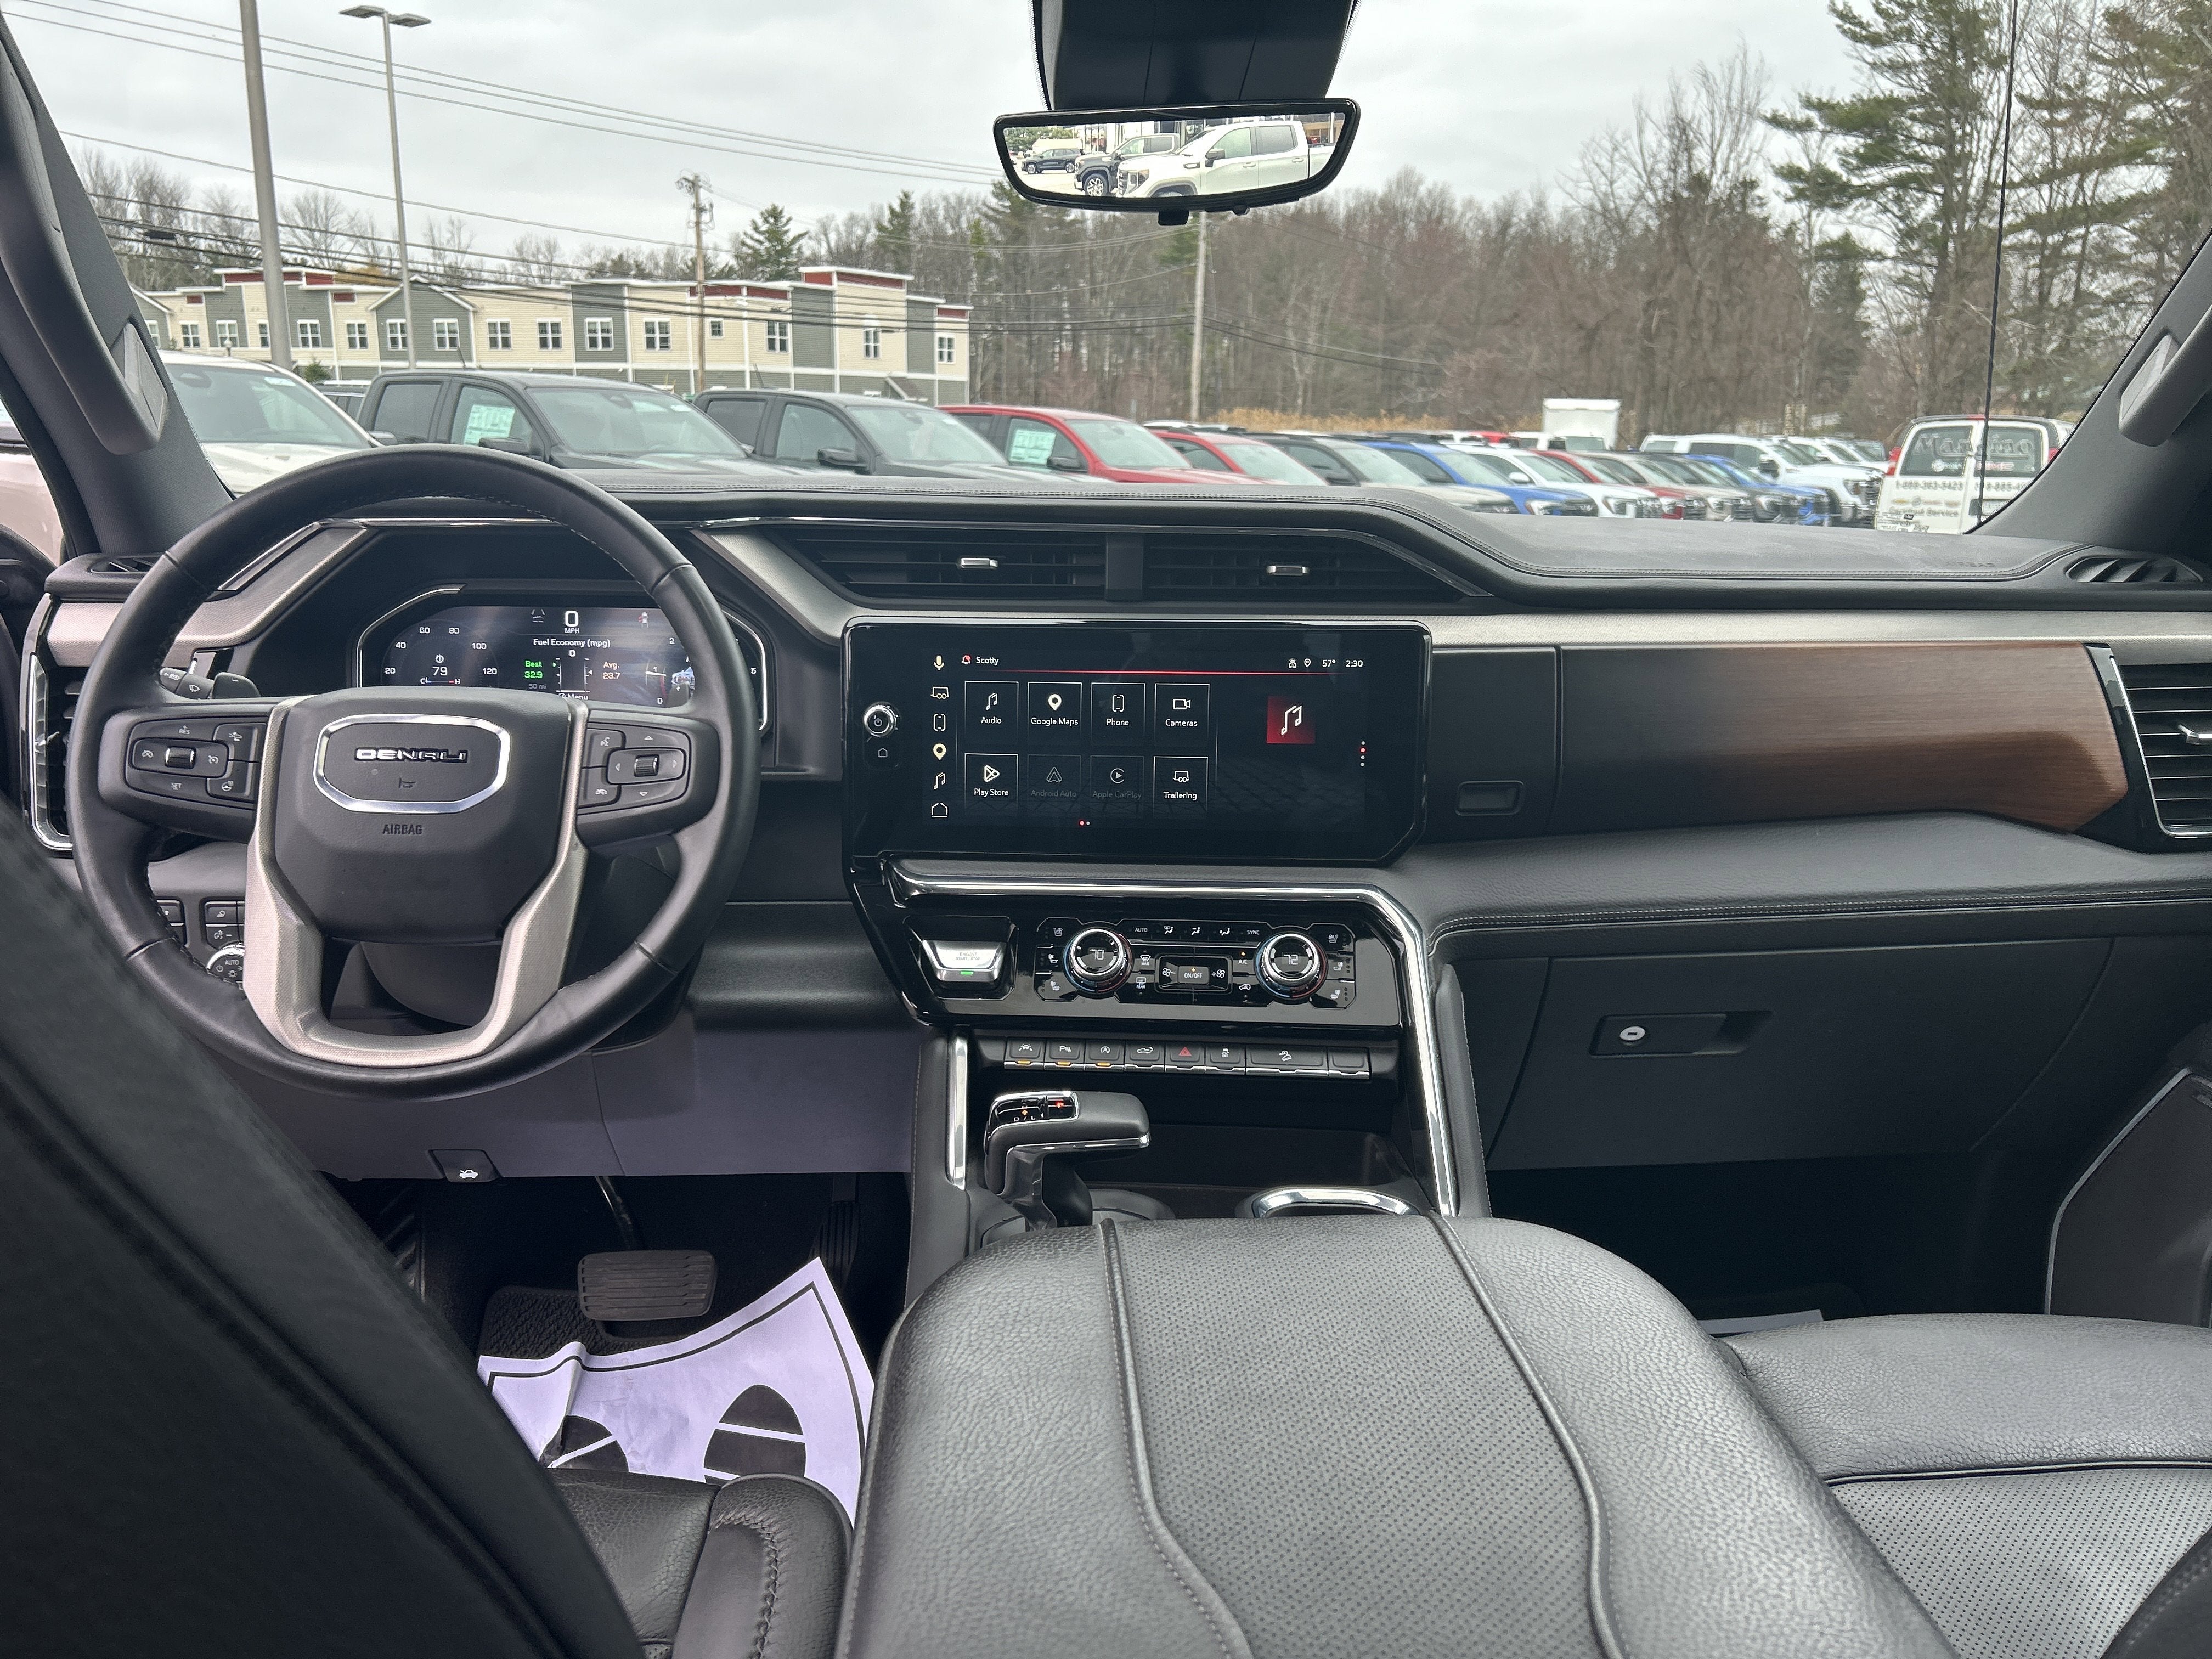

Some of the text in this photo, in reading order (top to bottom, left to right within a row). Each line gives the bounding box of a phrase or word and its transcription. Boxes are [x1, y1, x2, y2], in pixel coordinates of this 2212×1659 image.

[565, 610, 579, 627] 0
[551, 639, 586, 648] Economy
[587, 639, 611, 648] (mpg)
[603, 662, 620, 670] Avg.
[976, 657, 999, 666] Scotty
[432, 666, 448, 676] 79
[1031, 717, 1079, 727] Google Maps
[1106, 718, 1130, 726] Phone
[1165, 719, 1198, 727] Cameras
[355, 748, 467, 761] DENALI
[974, 788, 989, 797] Play
[1092, 790, 1142, 800] Apple CarPlay
[1163, 791, 1198, 801] Trailering
[382, 825, 423, 835] AIRBAG
[1090, 949, 1104, 960] 70
[1283, 954, 1299, 965] 72
